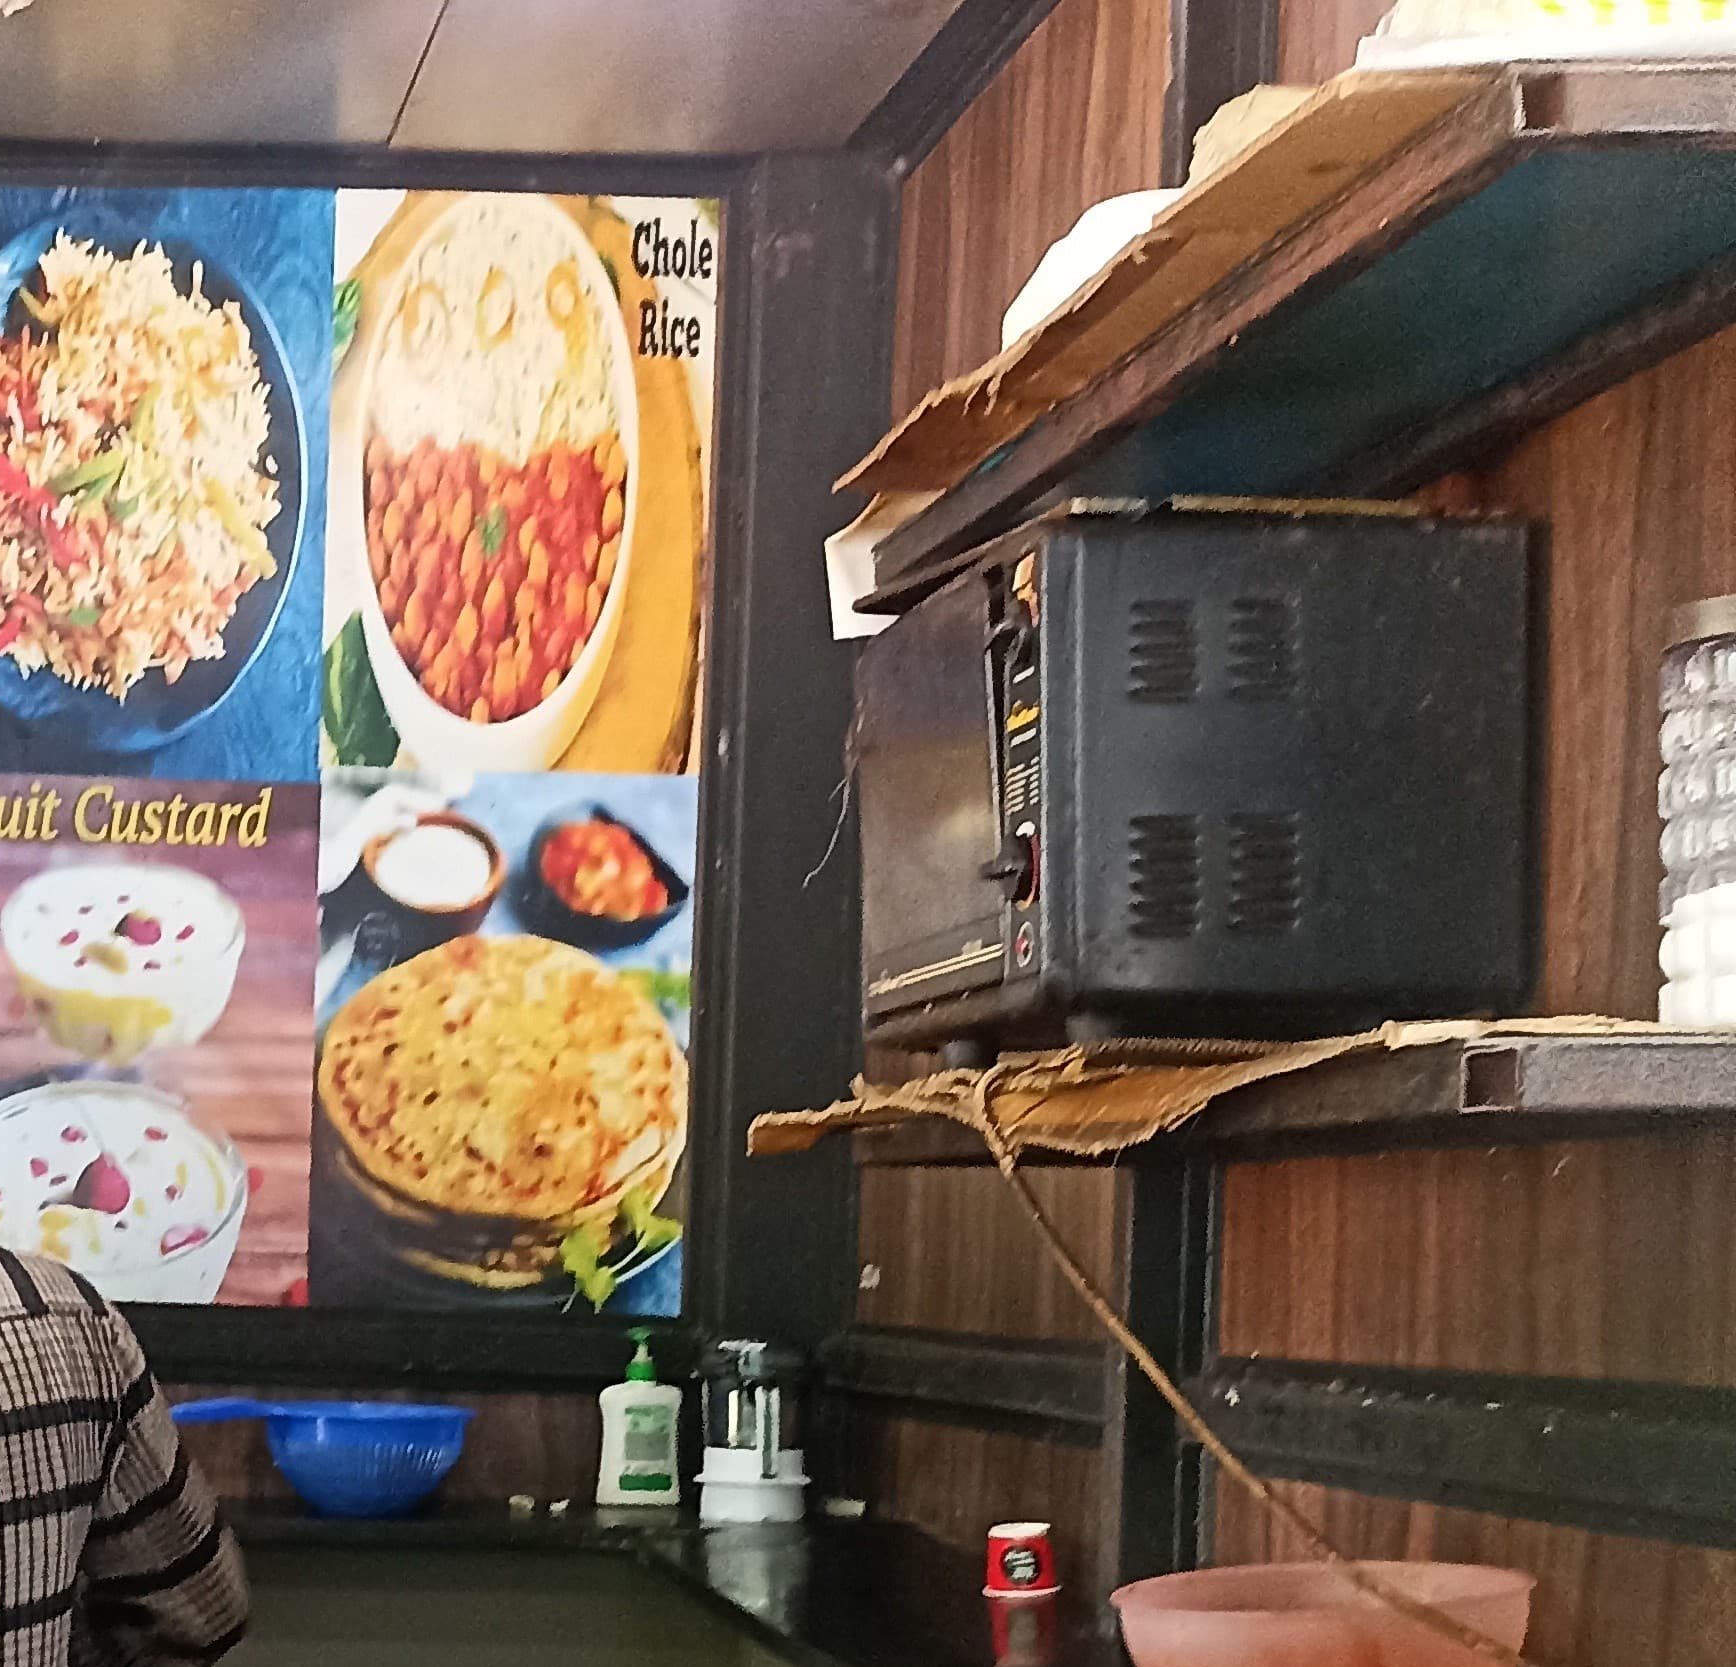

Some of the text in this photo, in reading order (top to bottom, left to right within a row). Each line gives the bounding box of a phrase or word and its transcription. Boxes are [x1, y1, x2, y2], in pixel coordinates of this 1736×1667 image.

[631, 217, 713, 279] Chole
[638, 297, 701, 358] Rice
[74, 783, 273, 848] Custard
